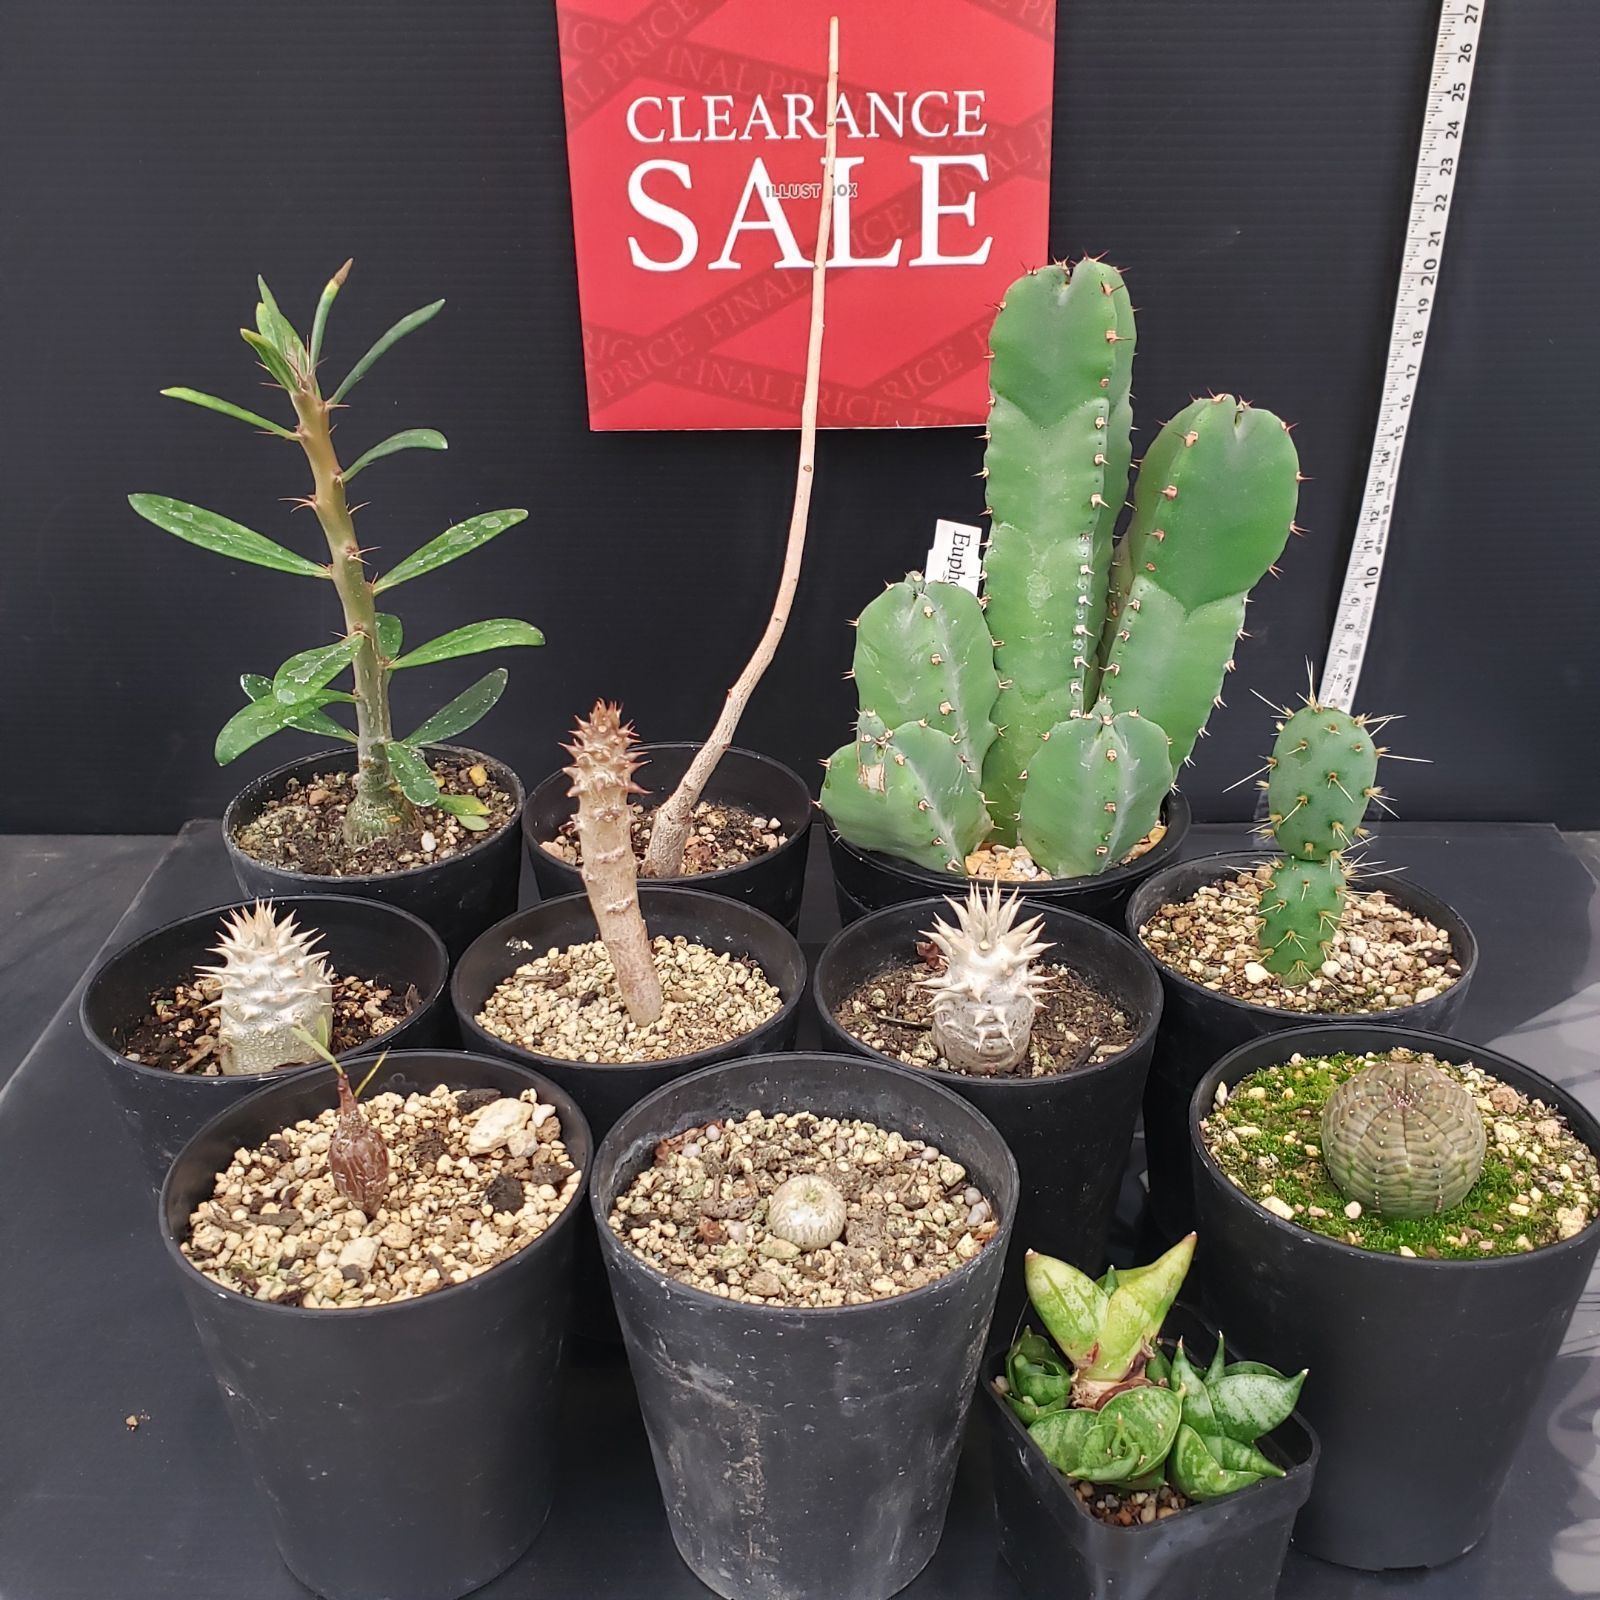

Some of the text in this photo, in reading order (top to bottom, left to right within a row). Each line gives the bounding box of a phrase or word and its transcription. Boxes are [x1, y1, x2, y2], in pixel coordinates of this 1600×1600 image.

[1464, 4, 1480, 24] 27
[1458, 43, 1473, 63] 26
[1452, 82, 1466, 102] 25
[626, 89, 988, 143] CLEARANCE
[1446, 121, 1461, 139] 24
[1439, 157, 1454, 176] 23
[766, 184, 857, 198] ILLUST OX
[1433, 194, 1448, 213] 22
[627, 154, 993, 272] SALE
[1428, 230, 1442, 248] 21
[1420, 258, 1438, 286] 20
[702, 270, 808, 337] FINAL
[1417, 298, 1430, 315] 19
[1411, 330, 1424, 347] 18
[1406, 364, 1417, 380] 17
[1400, 394, 1411, 411] 16
[1394, 425, 1405, 441] 15
[1381, 451, 1391, 464] 14
[1375, 481, 1385, 494] 13
[1369, 510, 1380, 523] 12
[1363, 539, 1374, 551] 11
[1363, 566, 1379, 589] 10
